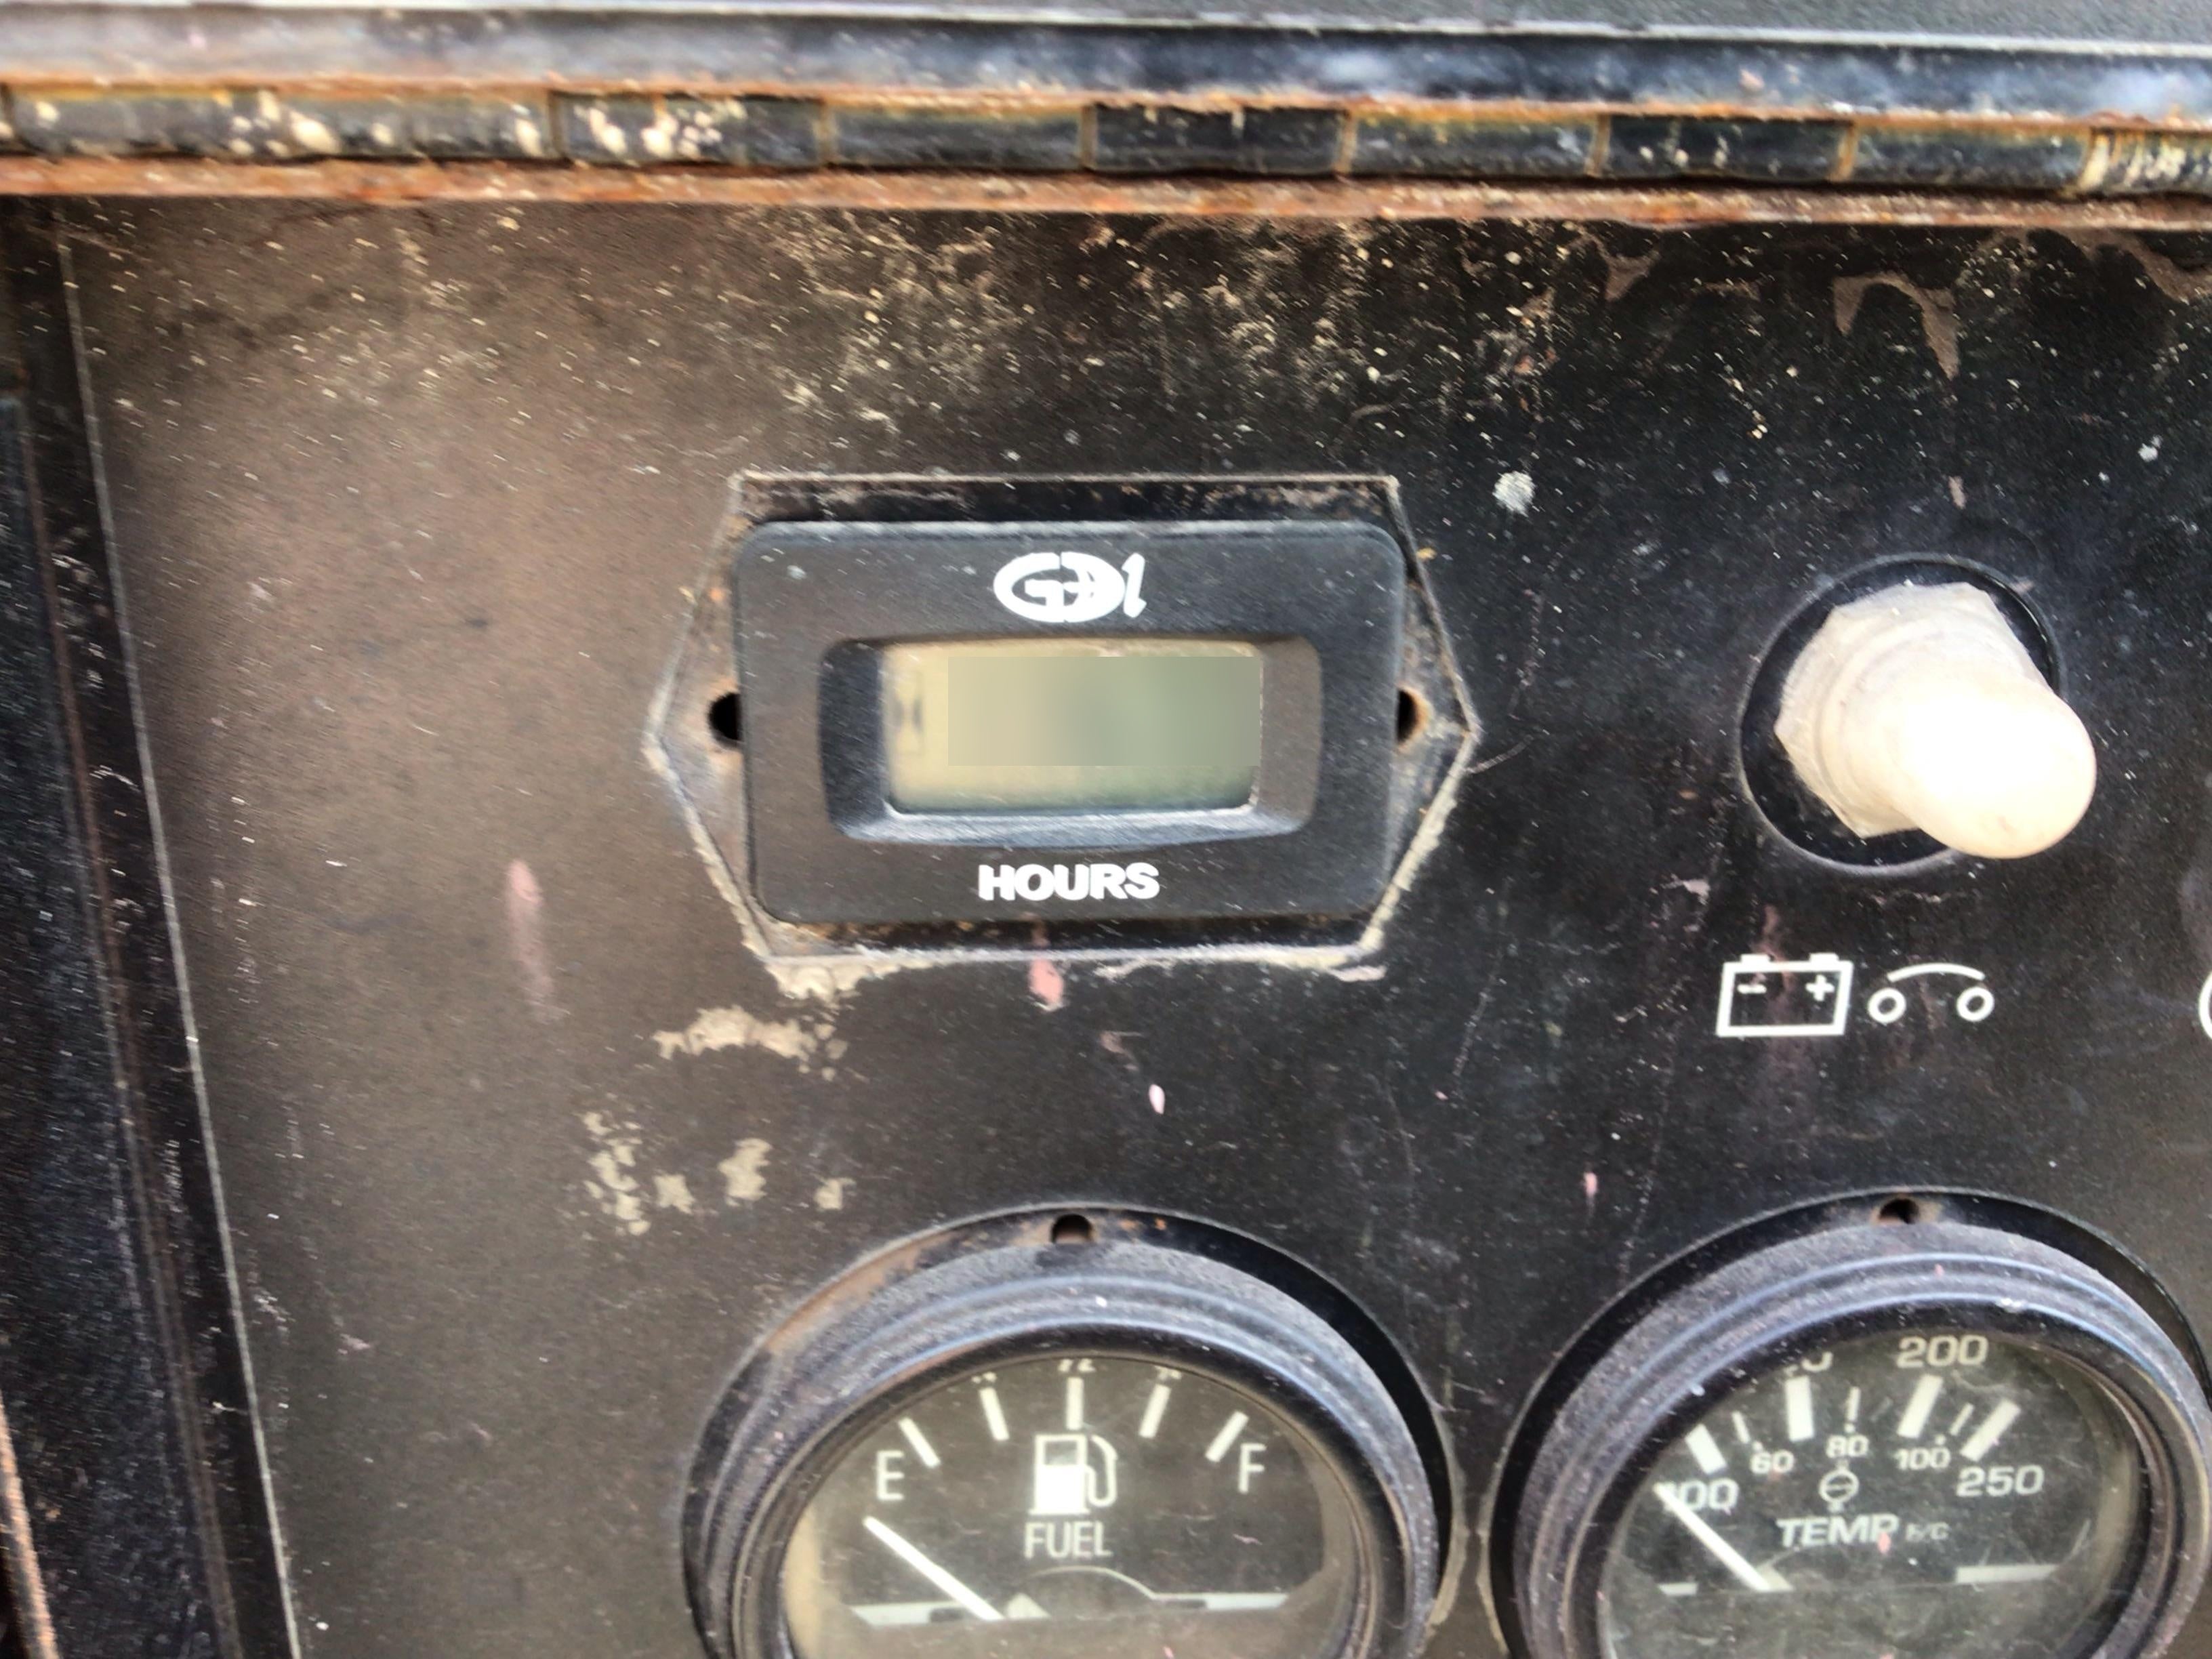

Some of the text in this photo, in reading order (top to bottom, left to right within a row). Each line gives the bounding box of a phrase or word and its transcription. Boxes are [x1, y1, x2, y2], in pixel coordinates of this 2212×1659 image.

[978, 863, 1160, 901] HOURS
[1897, 1335, 1988, 1368] 200
[1750, 1450, 1795, 1475] 60
[1826, 1434, 1869, 1458] 80
[1895, 1446, 1951, 1470] 100
[876, 1450, 905, 1501] E
[1239, 1443, 1267, 1493] F
[1956, 1465, 2045, 1497] 250
[1025, 1521, 1113, 1559] FUEL
[1776, 1513, 1900, 1549] TEMP
